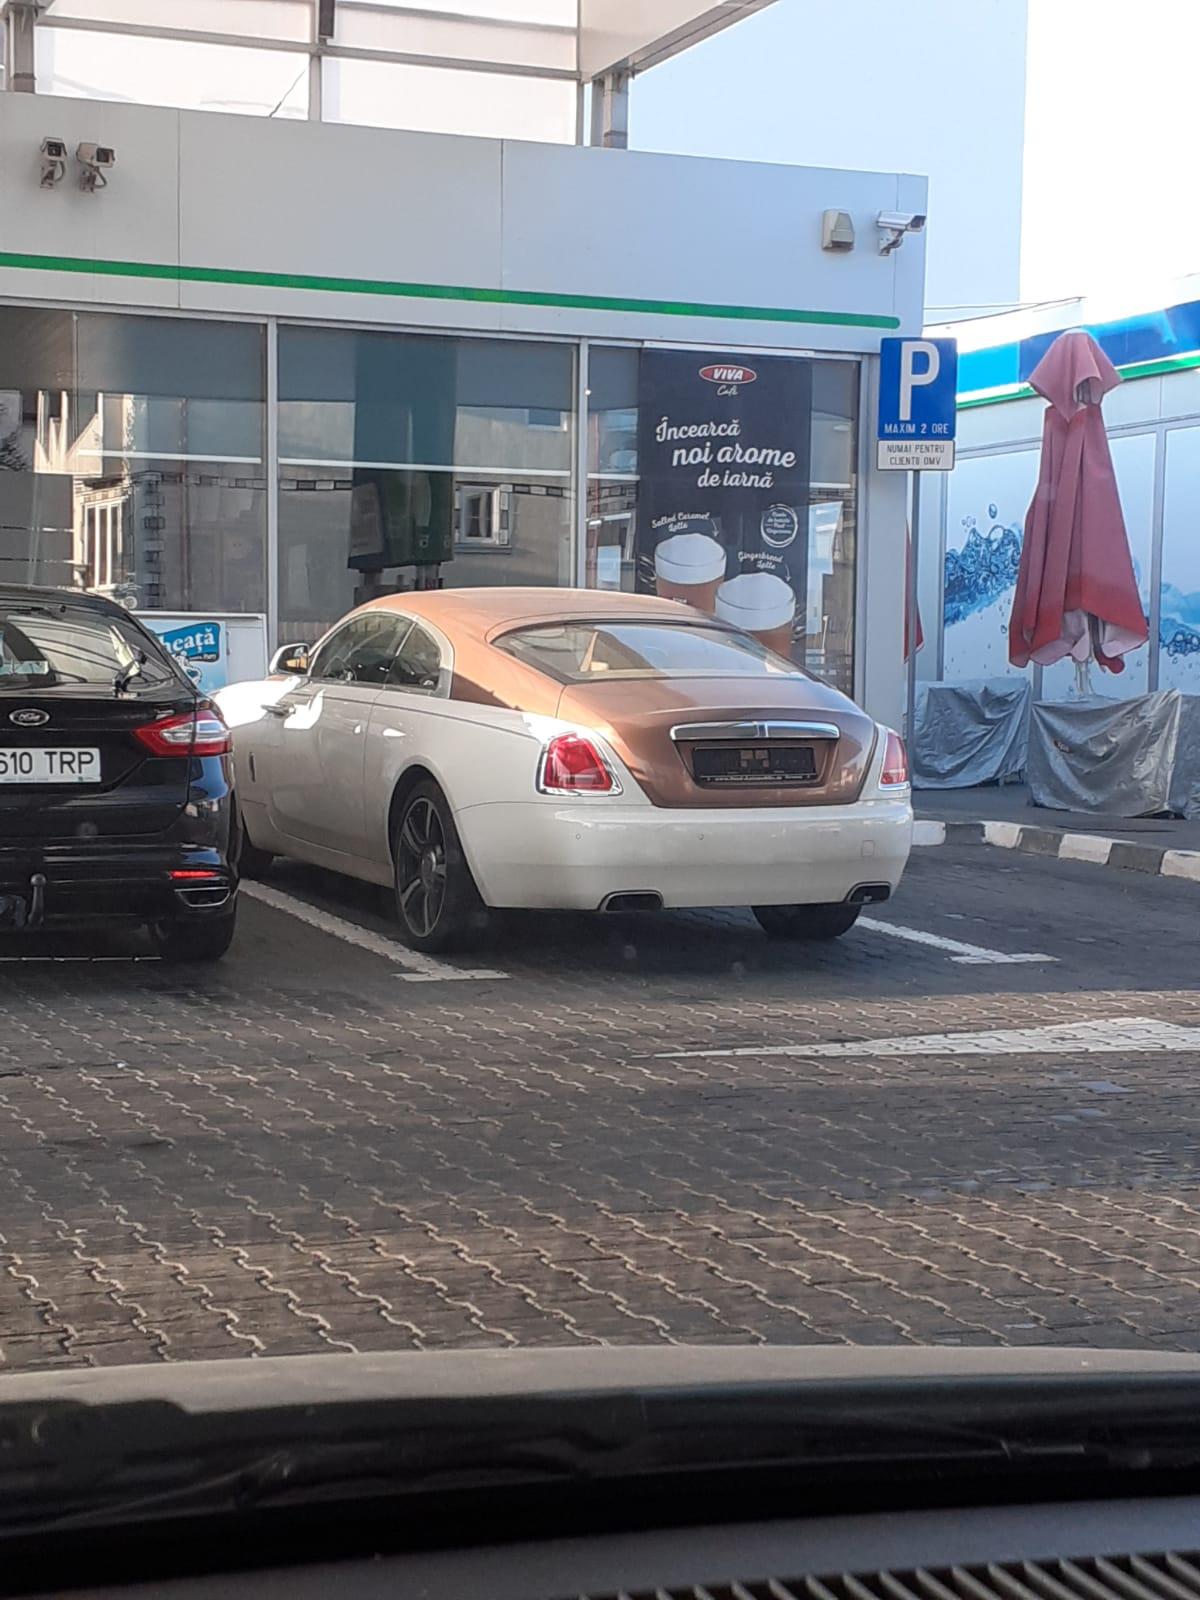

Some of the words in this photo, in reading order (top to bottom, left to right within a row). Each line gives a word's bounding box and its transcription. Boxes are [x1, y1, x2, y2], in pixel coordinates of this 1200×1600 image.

[713, 368, 744, 380] VIVA
[899, 341, 940, 421] P
[656, 416, 741, 442] Încearcă
[884, 423, 916, 434] MAXIM
[920, 423, 928, 434] 2
[931, 423, 949, 434] ORE
[672, 441, 714, 467] noi
[716, 443, 797, 468] arome
[887, 444, 912, 454] NUMAI
[914, 444, 945, 454] PENTRU
[923, 456, 941, 466] OMV
[697, 468, 721, 488] de
[724, 470, 774, 489] iarnă
[677, 511, 710, 521] Caramel
[158, 627, 216, 654] heață
[44, 751, 94, 775] TRP
